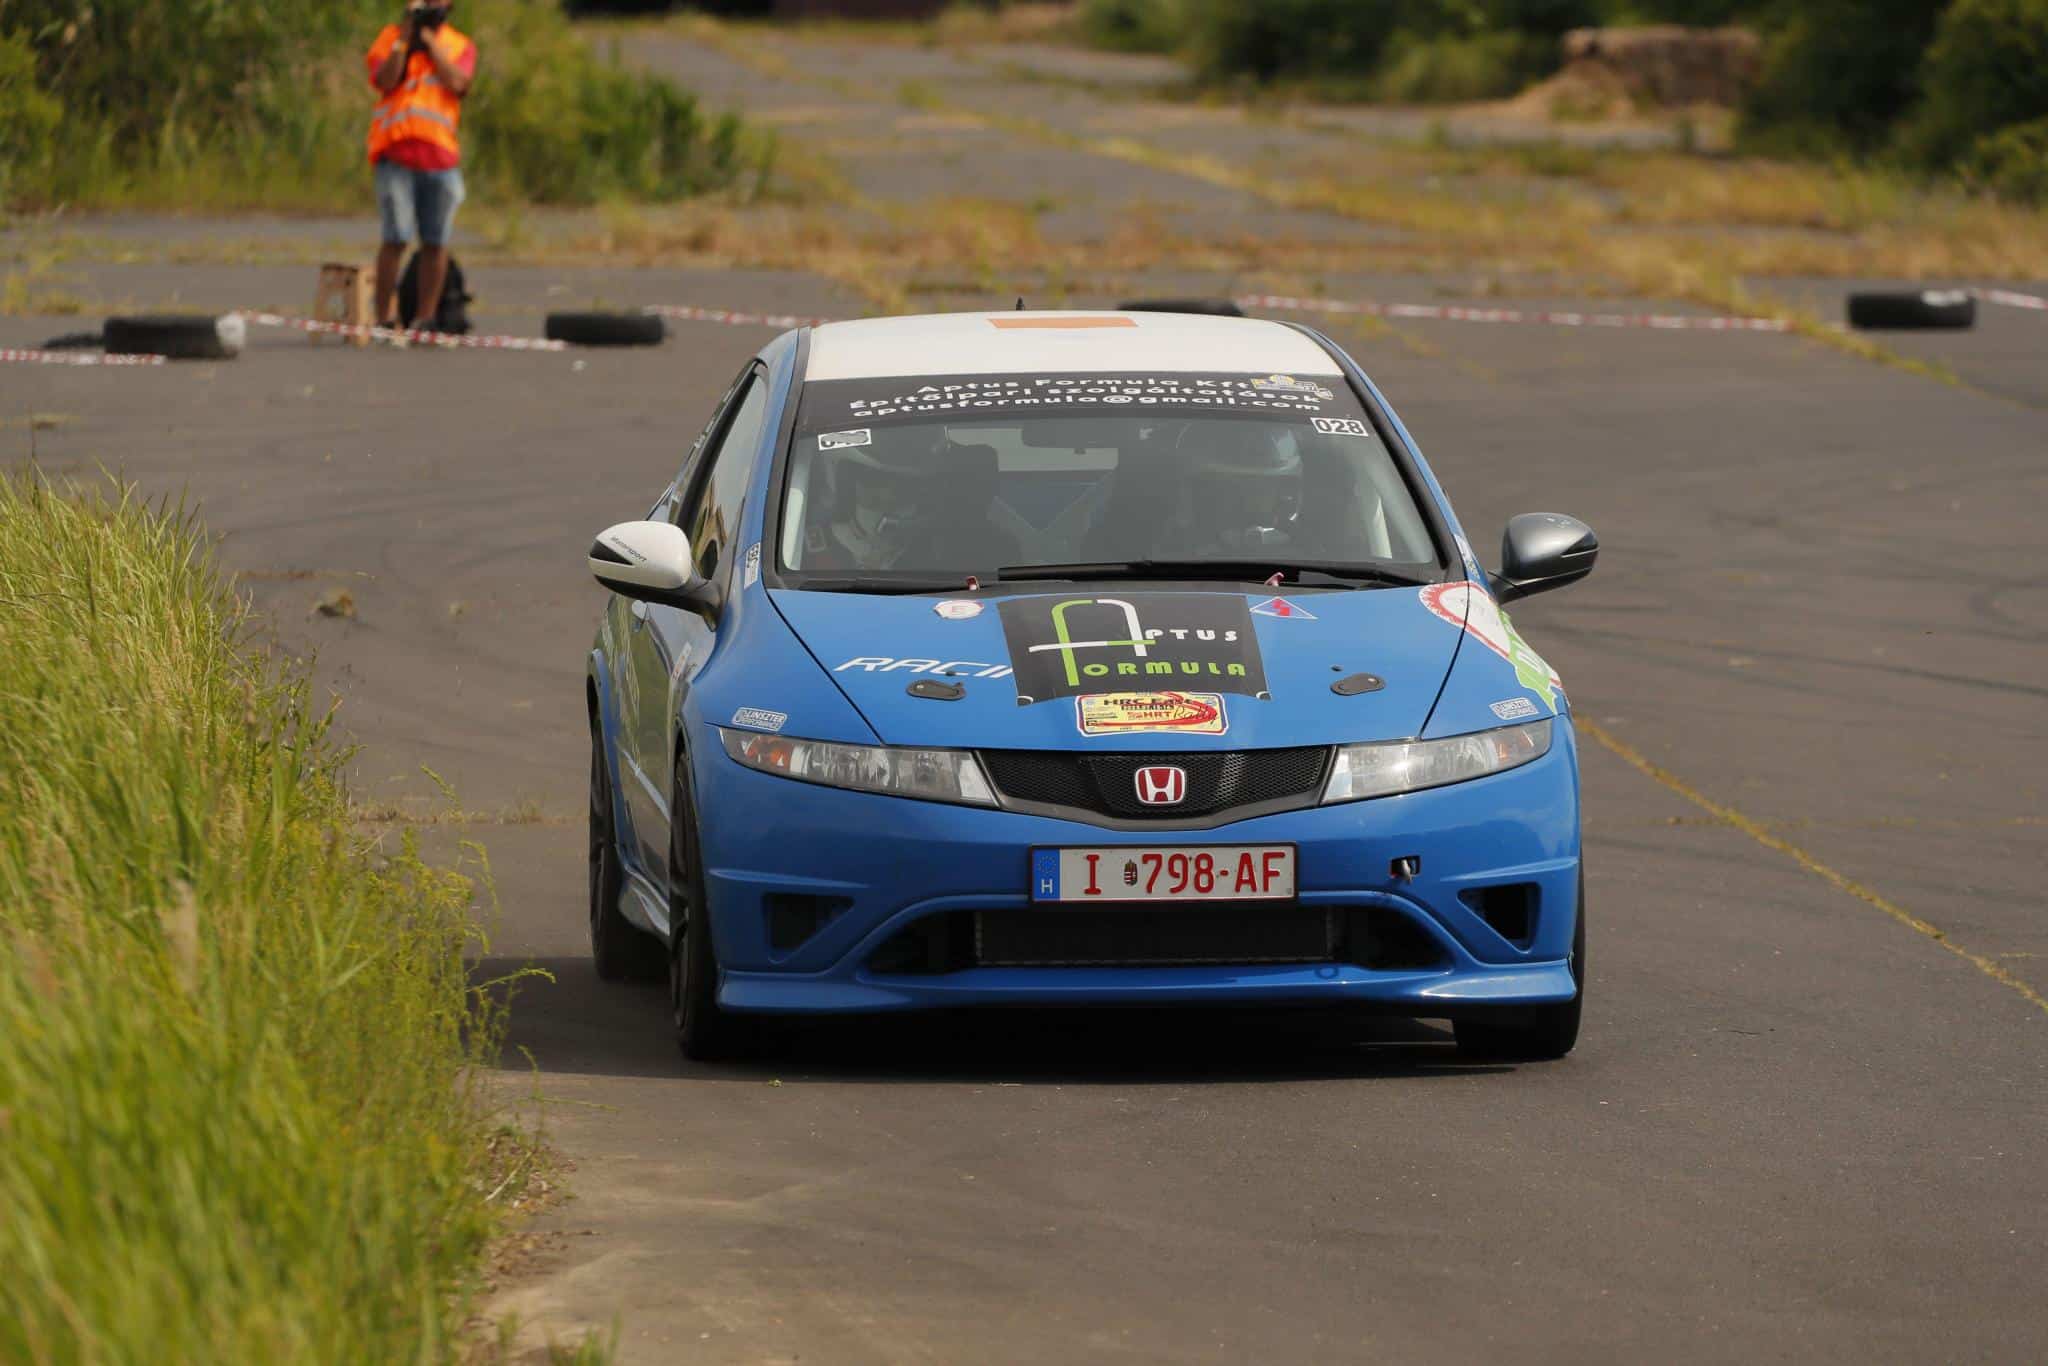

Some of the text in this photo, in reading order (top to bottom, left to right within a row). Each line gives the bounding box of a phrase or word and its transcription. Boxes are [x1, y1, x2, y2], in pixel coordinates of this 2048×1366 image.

[917, 381, 1019, 393] Aptus
[1035, 378, 1179, 387] Formula
[853, 395, 1321, 416] aptusformula@gmail.com
[1315, 419, 1364, 435] 028
[1142, 852, 1286, 895] 798-AF
[1040, 879, 1054, 894] H
